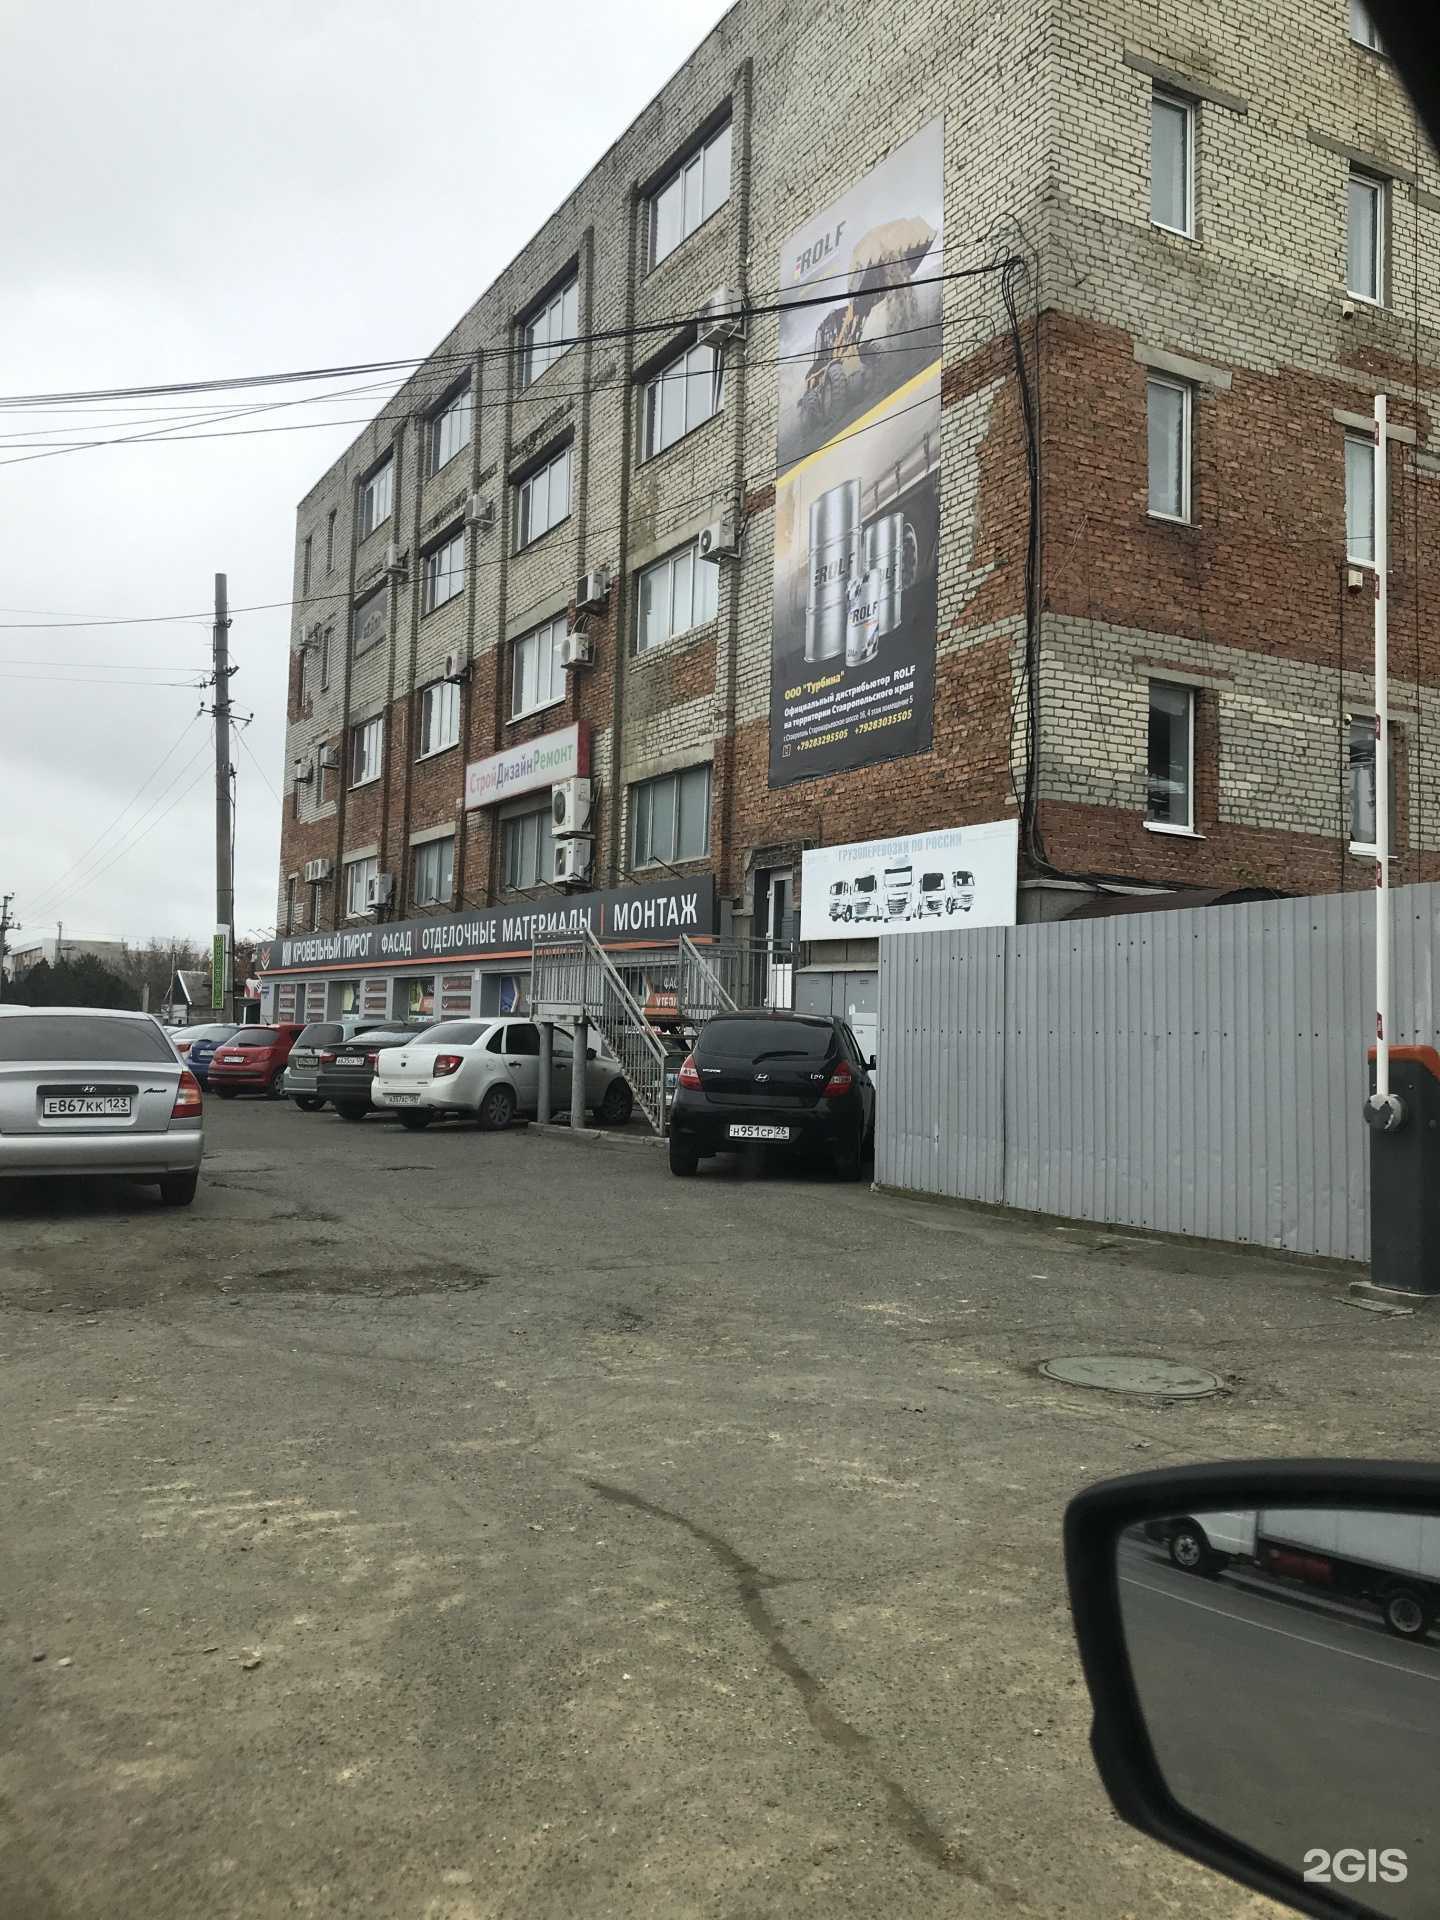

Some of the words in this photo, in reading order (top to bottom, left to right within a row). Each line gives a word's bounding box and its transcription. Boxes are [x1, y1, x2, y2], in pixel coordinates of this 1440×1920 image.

[799, 220, 847, 275] ROLF
[815, 552, 855, 584] ROLF
[851, 601, 878, 622] ROLF
[784, 692, 835, 717] Официальный
[835, 676, 890, 702] дистрибьютор
[893, 664, 916, 681] ROLF
[784, 686, 802, 700] ООО
[793, 709, 831, 727] территории
[831, 688, 894, 714] Ставропольского
[894, 681, 914, 695] края
[470, 744, 574, 797] СтройДизайнРемонт
[838, 839, 910, 862] ГРУЗОПЕРЕВОЗКИ
[911, 838, 923, 852] ПО
[926, 832, 962, 850] РОССИИ
[292, 932, 341, 963] КРОВЕЛЬНЫЙ
[343, 932, 372, 958] ПИРОГ
[381, 931, 412, 956] ФАСАД
[422, 919, 497, 953] ОТДЕЛОЧНЫЕ
[613, 893, 698, 932] МОНТАЖ
